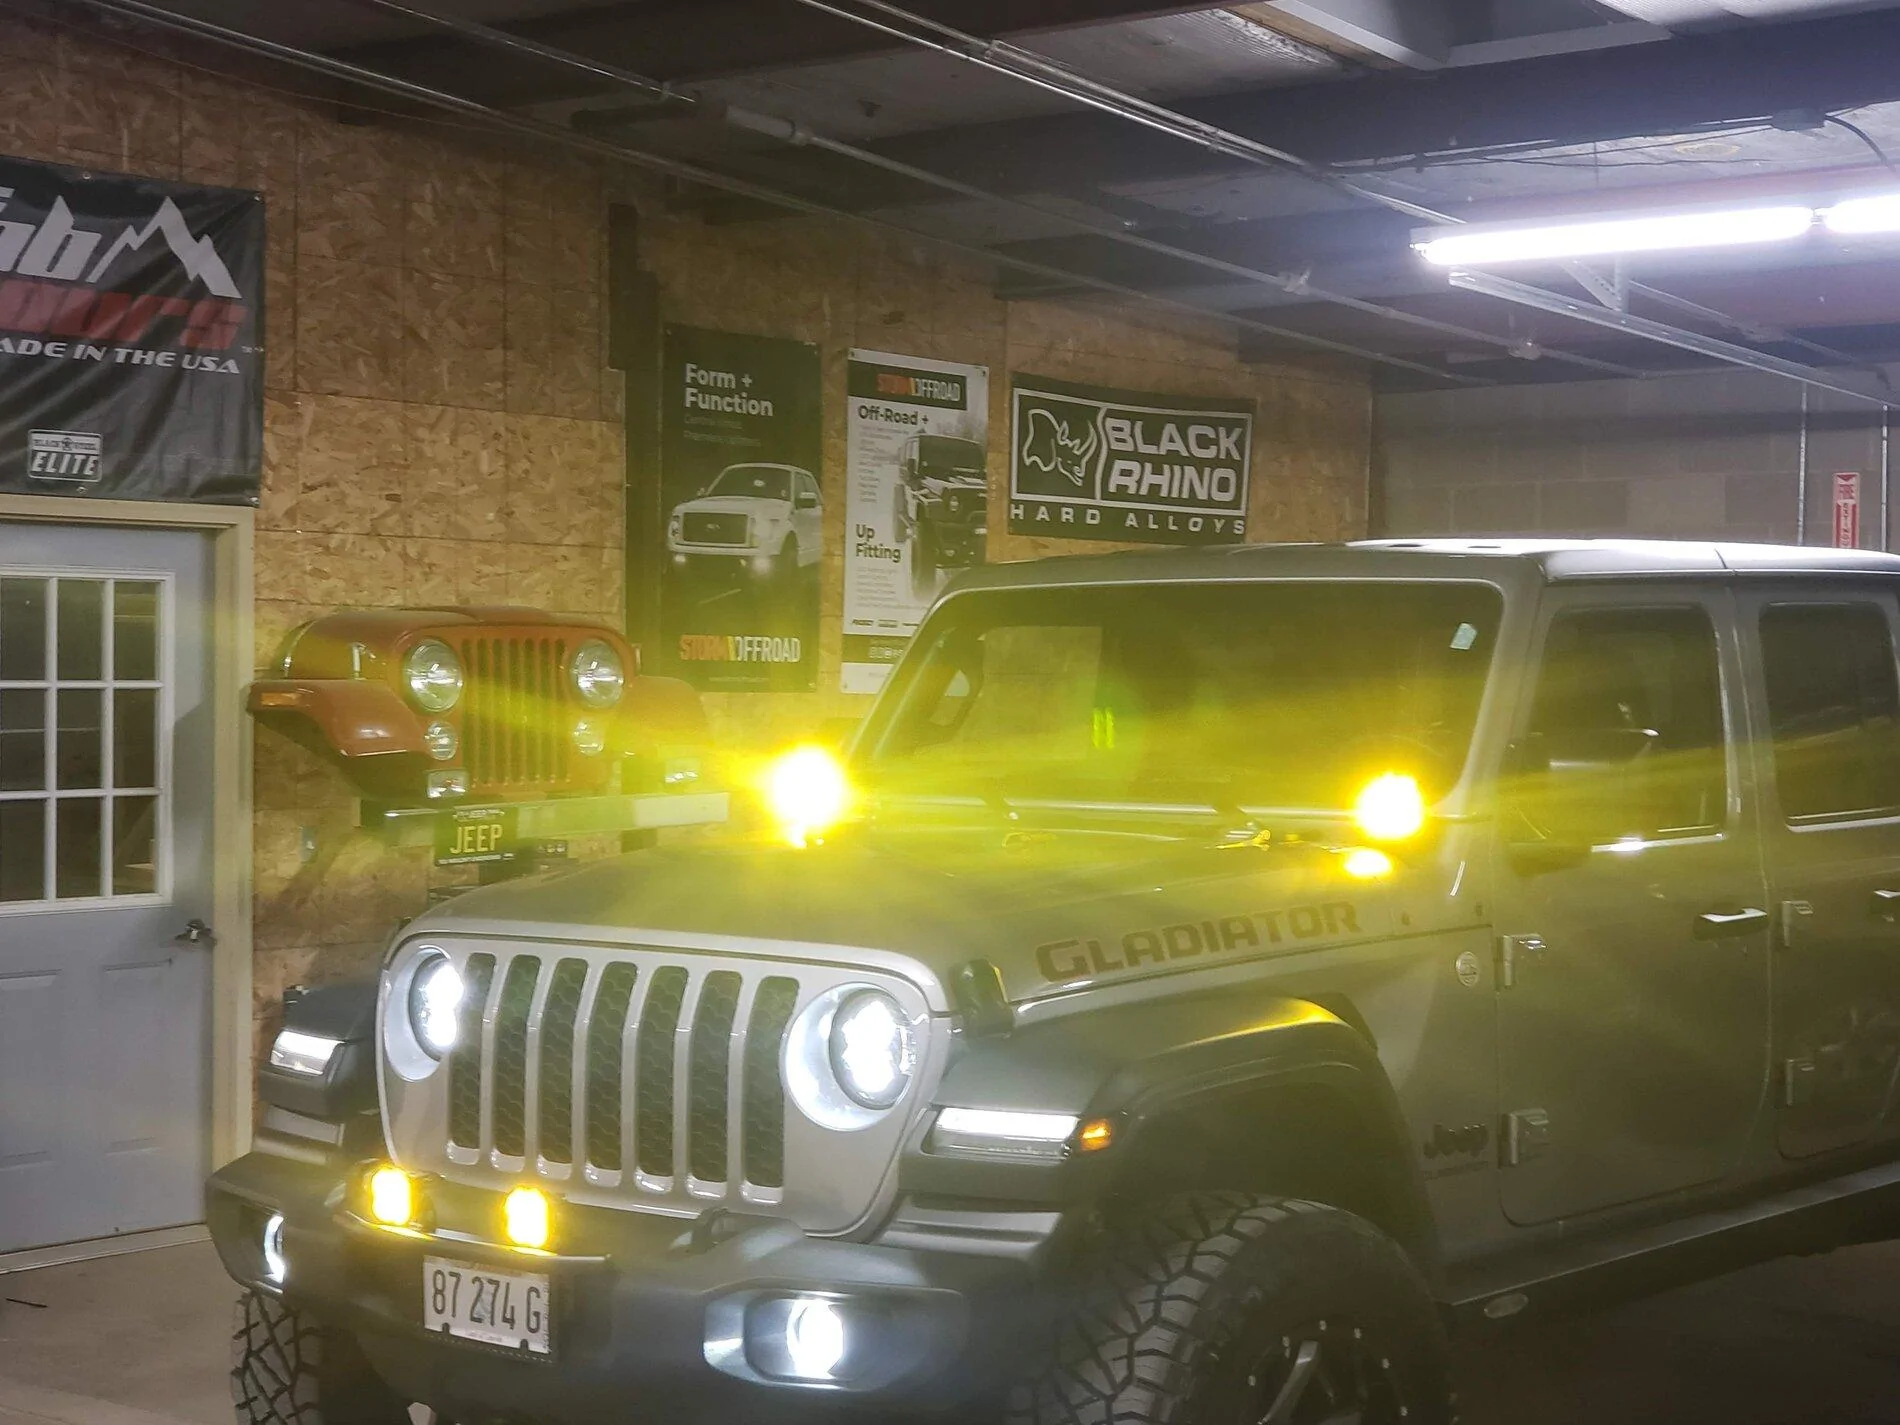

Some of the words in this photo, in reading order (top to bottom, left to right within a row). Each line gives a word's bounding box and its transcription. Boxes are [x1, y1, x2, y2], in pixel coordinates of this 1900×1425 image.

[0, 337, 67, 359] ADE
[73, 344, 106, 362] IN
[115, 347, 176, 368] THE
[182, 354, 240, 375] USA
[685, 363, 736, 389] Form
[684, 387, 774, 417] Function
[858, 405, 918, 426] Off-Road
[1103, 417, 1243, 461] BLACK
[31, 451, 99, 476] ELITE
[1107, 459, 1237, 502] RHINO
[855, 523, 876, 542] Up
[1009, 503, 1101, 525] HARD
[1124, 512, 1246, 535] ALLOYS
[855, 543, 902, 564] Fitting
[449, 823, 503, 855] JEEP
[1035, 901, 1366, 984] GLADIATOR
[432, 1269, 462, 1318] 87
[469, 1276, 516, 1331] 274
[526, 1286, 541, 1334] G
